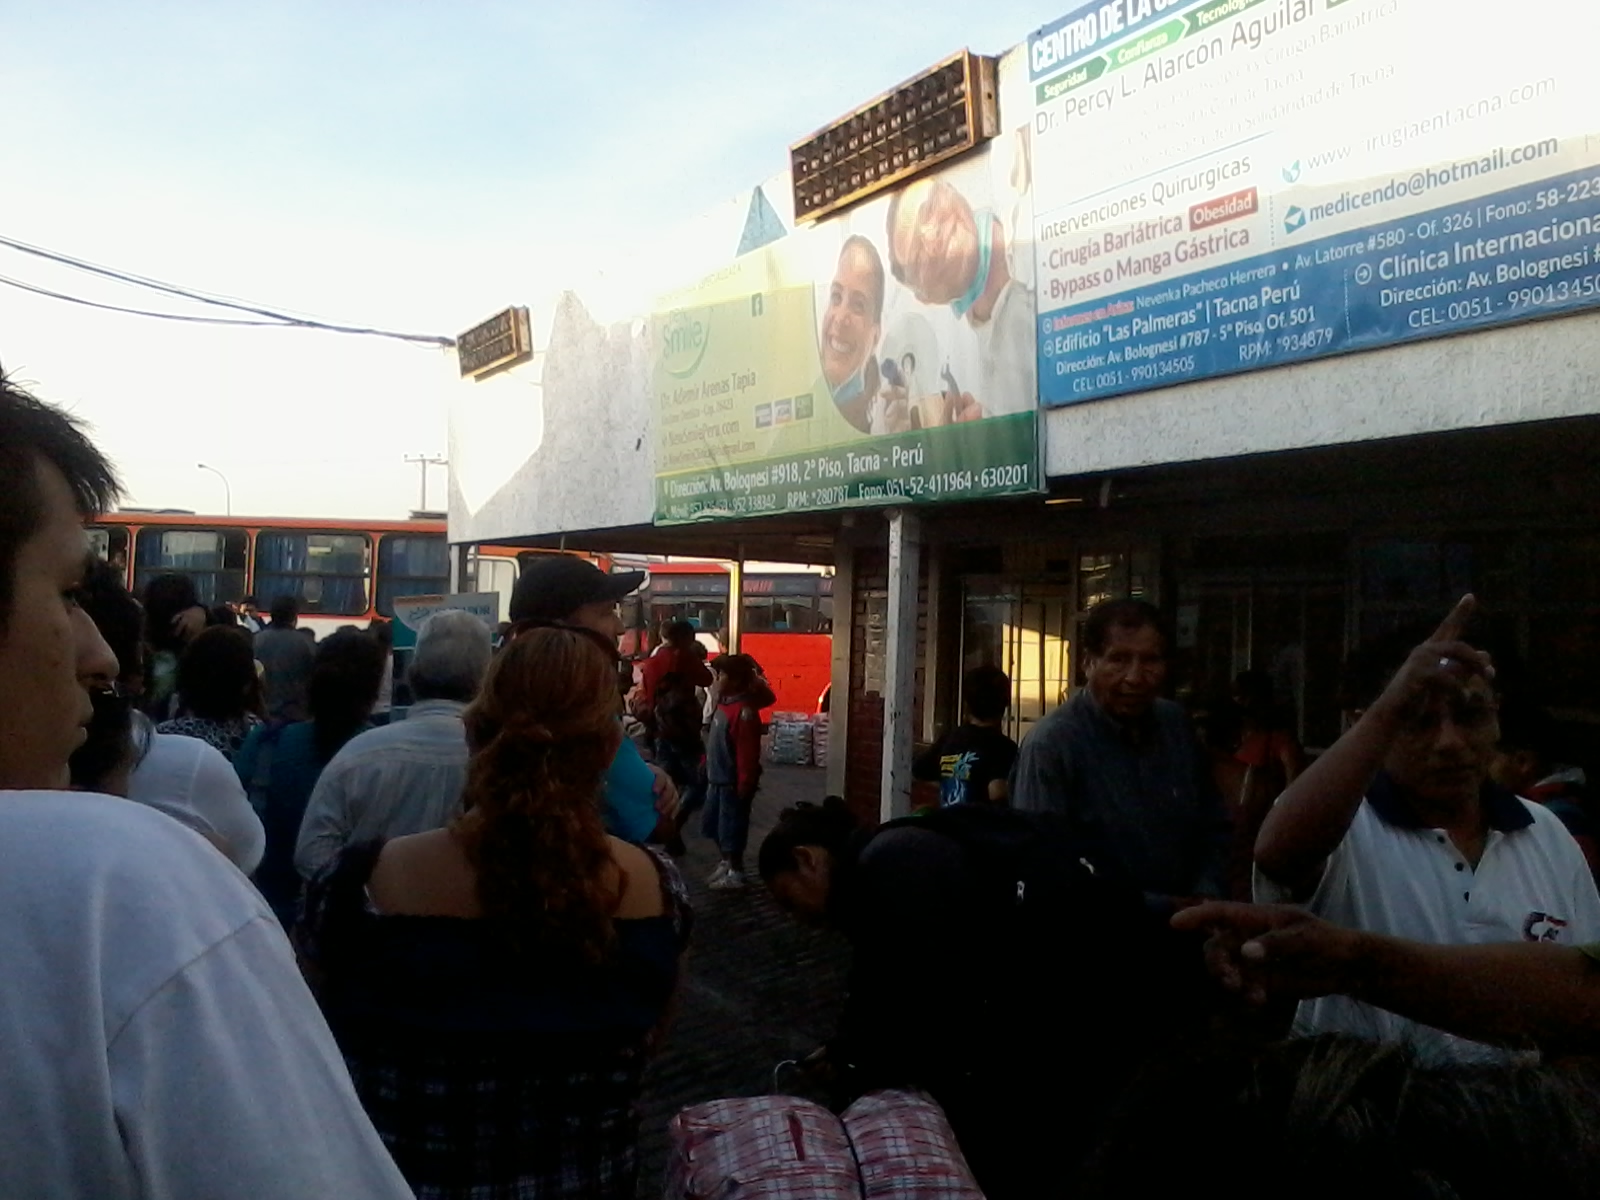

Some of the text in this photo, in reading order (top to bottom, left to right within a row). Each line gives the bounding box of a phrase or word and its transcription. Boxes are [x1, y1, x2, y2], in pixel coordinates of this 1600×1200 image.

[1032, 12, 1097, 73] CENTRO
[1099, 0, 1124, 40] DE
[1196, 0, 1254, 27] Tecnolog
[1036, 111, 1059, 136] Dr.
[1064, 85, 1116, 123] Percy
[1121, 75, 1137, 98] L.
[1143, 37, 1223, 89] Alarcón
[1231, 0, 1313, 51] Aguilar
[1117, 32, 1169, 64] Confianza
[1044, 67, 1088, 99] Seguridad
[1309, 136, 1559, 222] medicendo@hotmail.com
[1040, 192, 1147, 242] Intervenciones
[1049, 191, 1253, 270] Cirugía Bariátrica Obesidad
[1050, 228, 1250, 299] Bypass o Manga Gástrica
[1136, 288, 1181, 310] Nevenka
[1182, 276, 1228, 299] Pacheco
[1230, 264, 1276, 287] Herrera
[1295, 253, 1313, 271] Av.
[1315, 240, 1364, 265] Latorre
[1367, 228, 1405, 252] #580
[1417, 219, 1439, 240] Of.
[1443, 211, 1474, 235] 326
[1485, 200, 1532, 223] Fono:
[1379, 250, 1449, 281] Clínica
[1380, 277, 1463, 308] Dirección:
[1466, 270, 1491, 291] Av.
[1497, 245, 1589, 284] Bolognesi
[1055, 328, 1101, 355] Edificio
[1213, 295, 1258, 318] Tacna
[1261, 279, 1301, 307] Perú
[1448, 296, 1493, 321] 0051
[1056, 354, 1105, 376] Dirección:
[1107, 350, 1123, 365] Av.
[1124, 337, 1178, 362] Bolognesi
[1179, 327, 1210, 350] #787
[1266, 311, 1288, 330] Of.
[1290, 305, 1316, 326] 501
[1239, 340, 1273, 362] RPM:
[701, 379, 730, 398] Arenas
[731, 369, 756, 394] Tapia
[1096, 370, 1123, 389] 0051
[1131, 355, 1195, 381] 990134505
[709, 473, 723, 492] Av.
[724, 466, 769, 495] Bolognesi
[771, 461, 802, 485] #918,
[818, 456, 844, 480] Piso,
[847, 452, 880, 474] Tacna
[892, 443, 924, 468] Perú
[787, 490, 810, 508] RPM:
[859, 482, 885, 500] Fono:
[886, 470, 972, 498] 051-52-411964
[981, 464, 1029, 488] 630201
